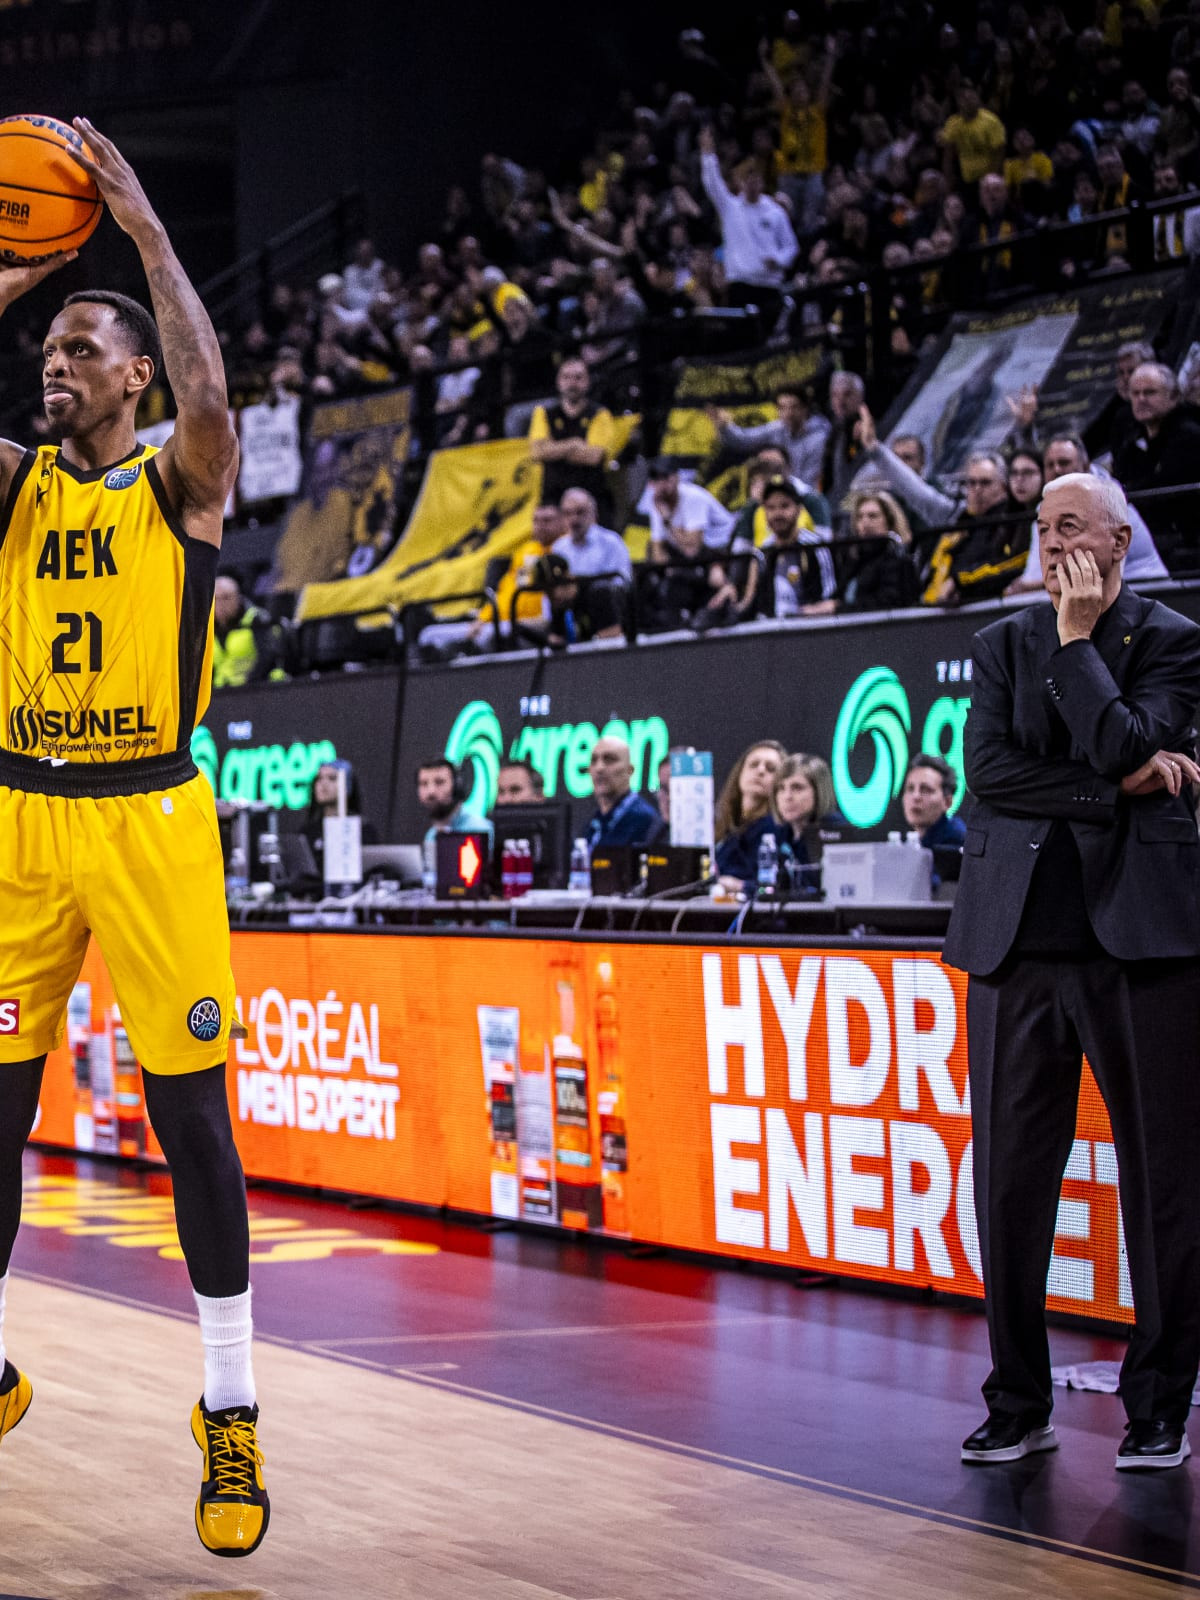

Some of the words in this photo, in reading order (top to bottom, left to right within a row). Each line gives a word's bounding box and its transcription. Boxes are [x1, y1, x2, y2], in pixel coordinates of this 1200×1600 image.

[0, 199, 31, 218] FIBA
[36, 525, 118, 580] AEK
[52, 611, 103, 674] 21
[41, 738, 111, 753] Empowering
[114, 736, 157, 750] Change
[42, 705, 157, 739] SUNEL
[234, 986, 400, 1078] L'ORÉAL
[701, 952, 972, 1118] HYDR
[236, 1069, 296, 1128] MEN
[296, 1075, 400, 1141] EXPERT
